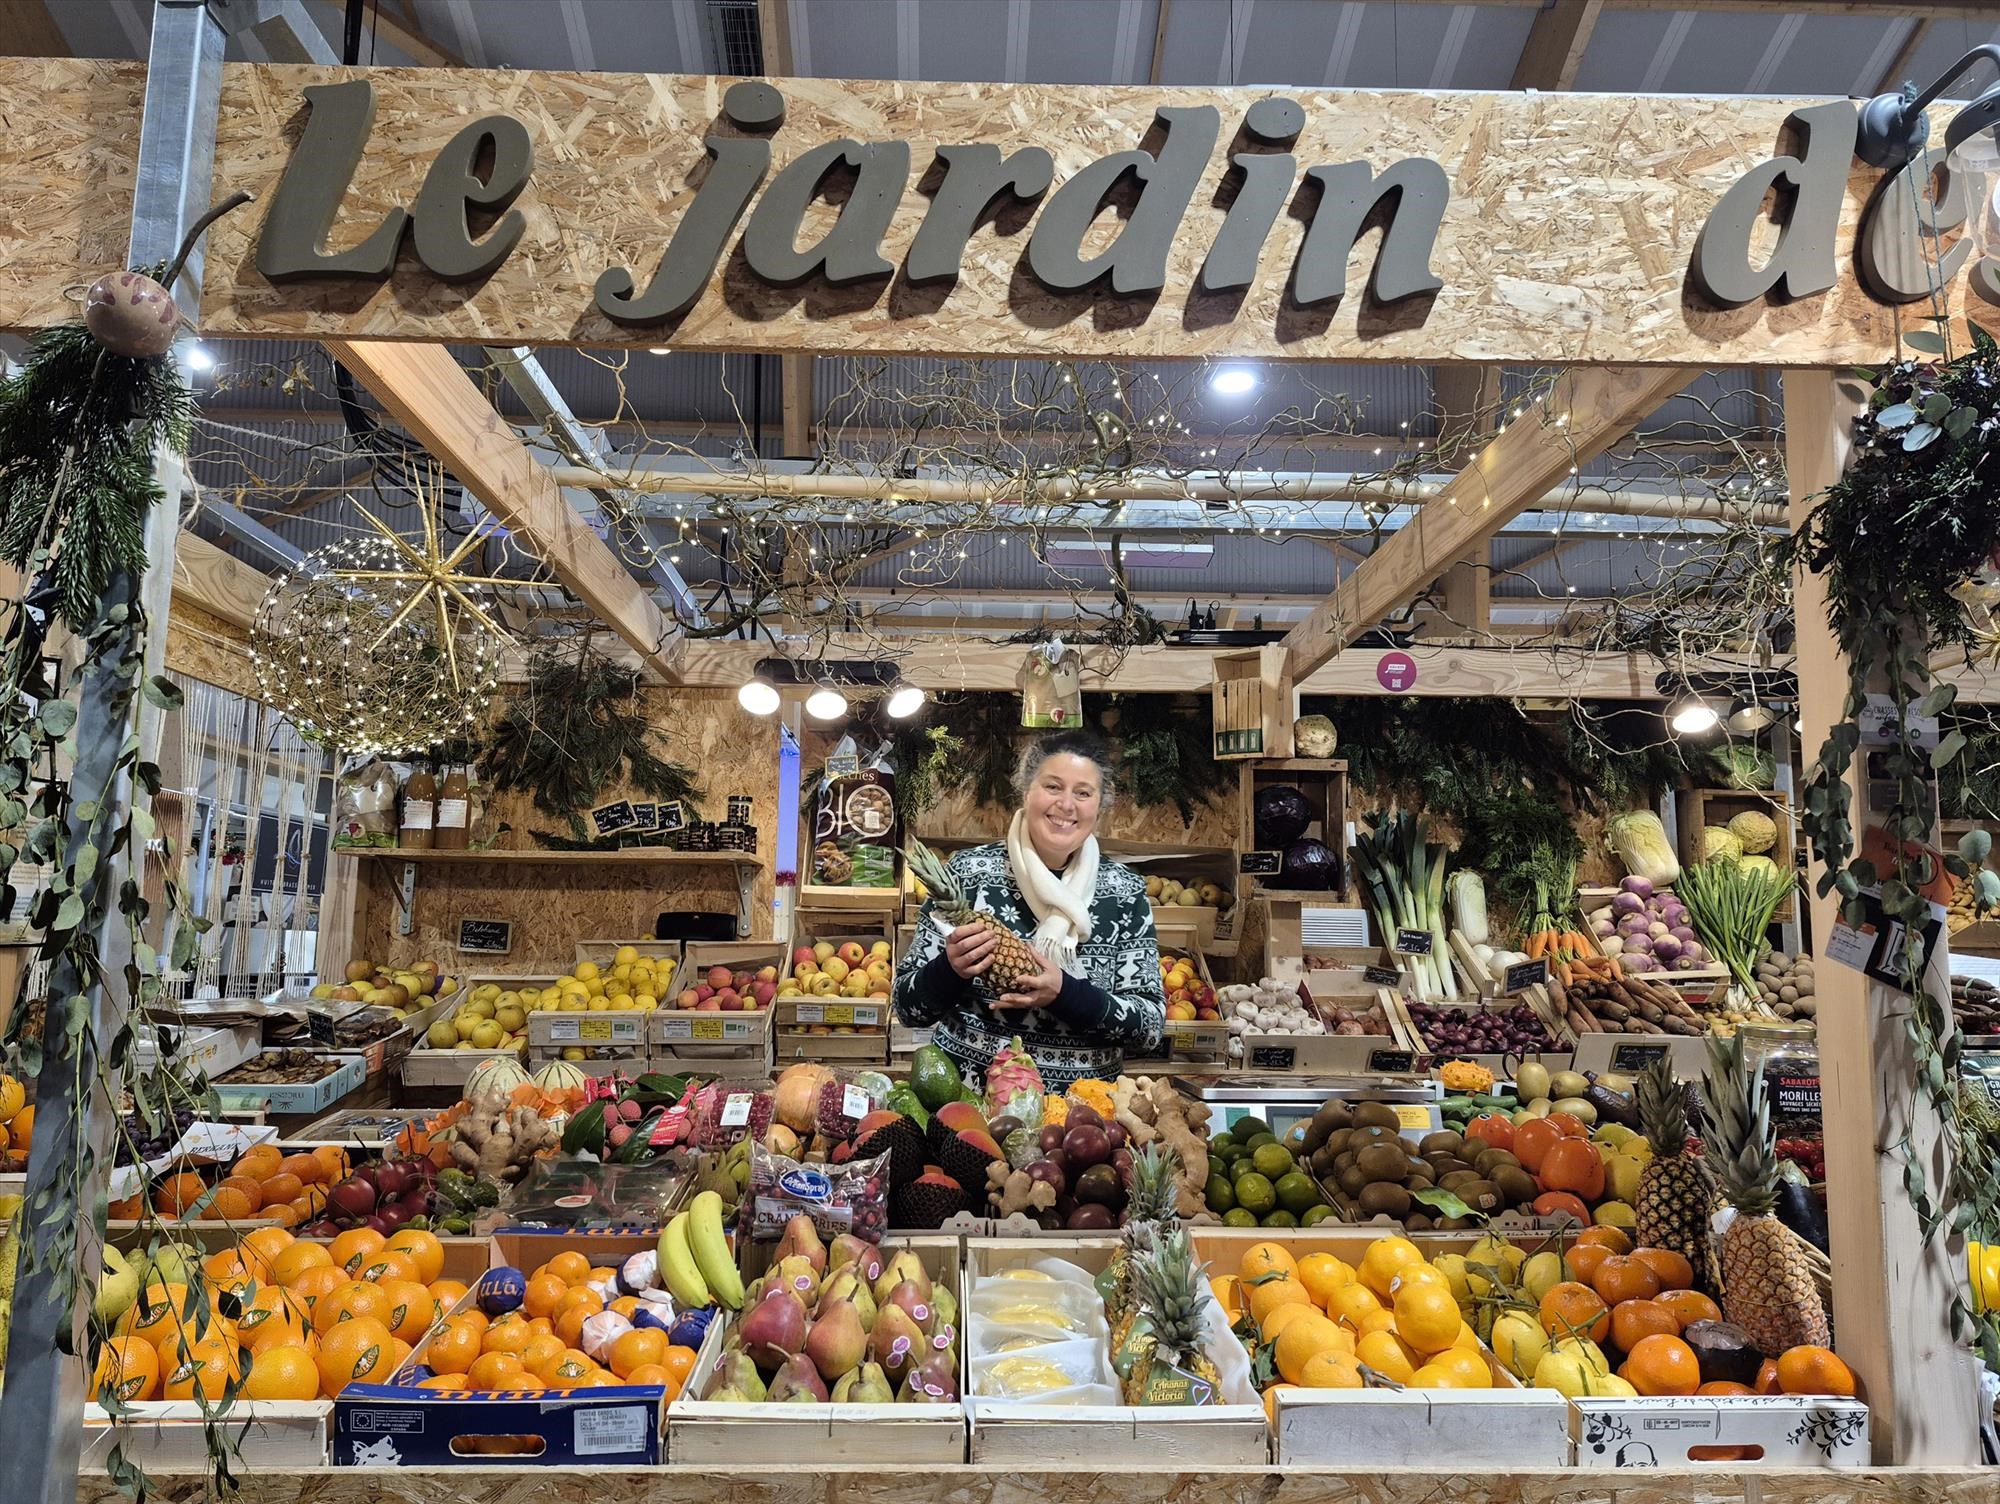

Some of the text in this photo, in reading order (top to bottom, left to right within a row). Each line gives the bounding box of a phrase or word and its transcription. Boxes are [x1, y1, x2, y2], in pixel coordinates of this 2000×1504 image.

[256, 79, 2000, 327] Le jardin de
[816, 783, 895, 839] BIO
[1147, 1390, 1185, 1402] Victoria
